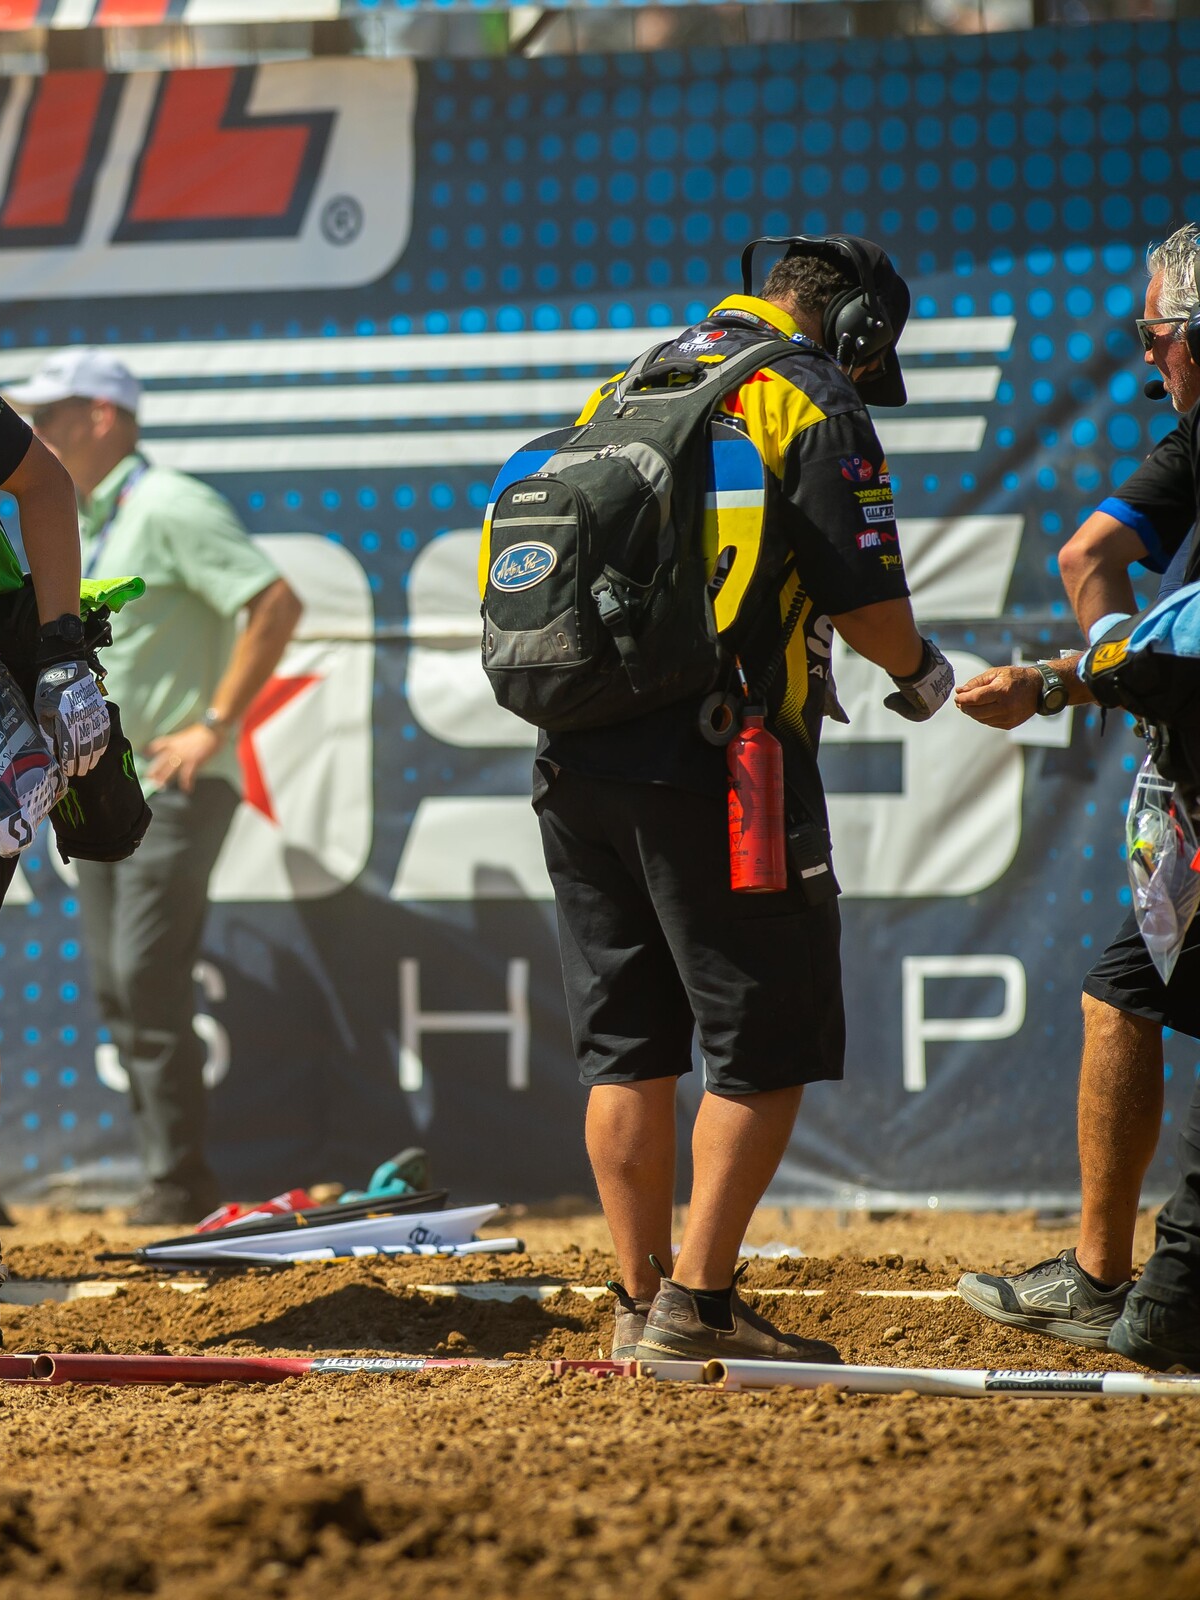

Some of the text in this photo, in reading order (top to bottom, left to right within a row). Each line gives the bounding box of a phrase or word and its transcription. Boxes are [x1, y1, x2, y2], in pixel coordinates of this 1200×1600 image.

[511, 491, 548, 504] OGIO
[322, 1357, 426, 1370] Hangtown
[993, 1381, 1048, 1390] Motocross
